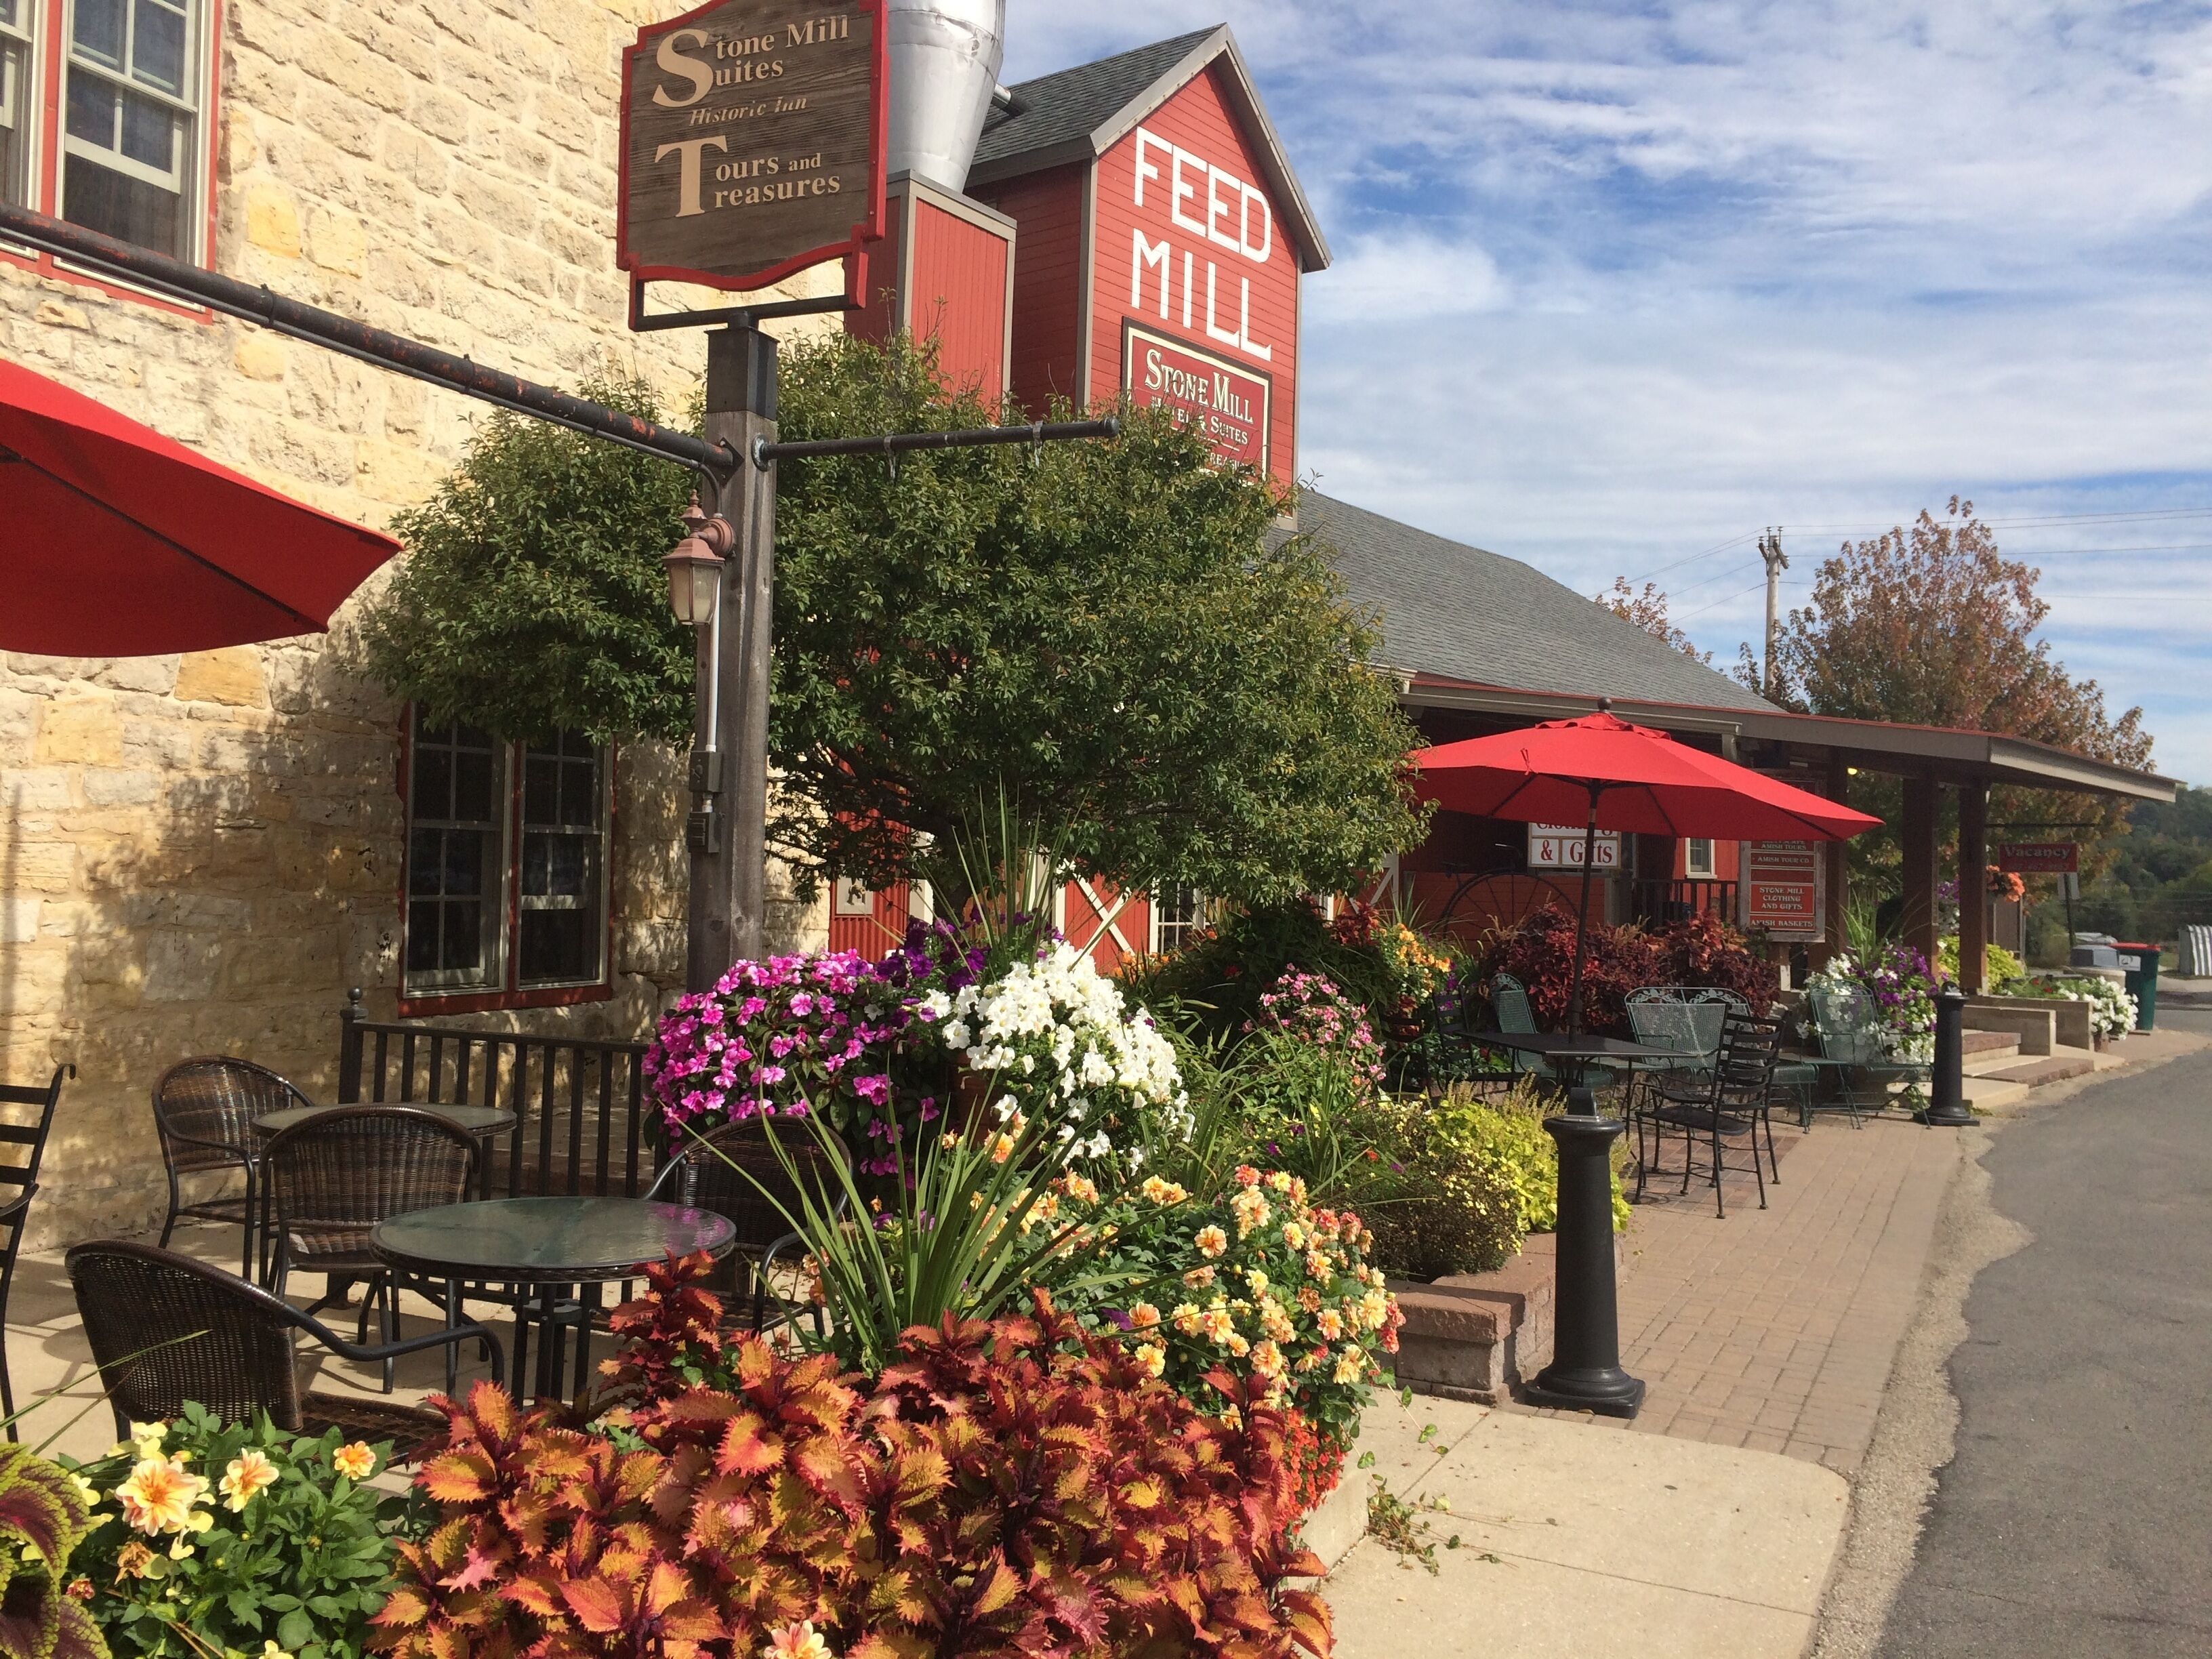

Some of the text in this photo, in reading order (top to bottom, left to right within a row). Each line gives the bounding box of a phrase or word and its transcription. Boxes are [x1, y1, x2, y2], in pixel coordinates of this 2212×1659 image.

[785, 14, 848, 48] Mill
[689, 100, 766, 127] Historic
[788, 152, 821, 171] and
[1134, 126, 1271, 264] FEED
[1131, 228, 1271, 361] MILL
[1540, 840, 1553, 861] &
[2005, 846, 2071, 859] Vacancy
